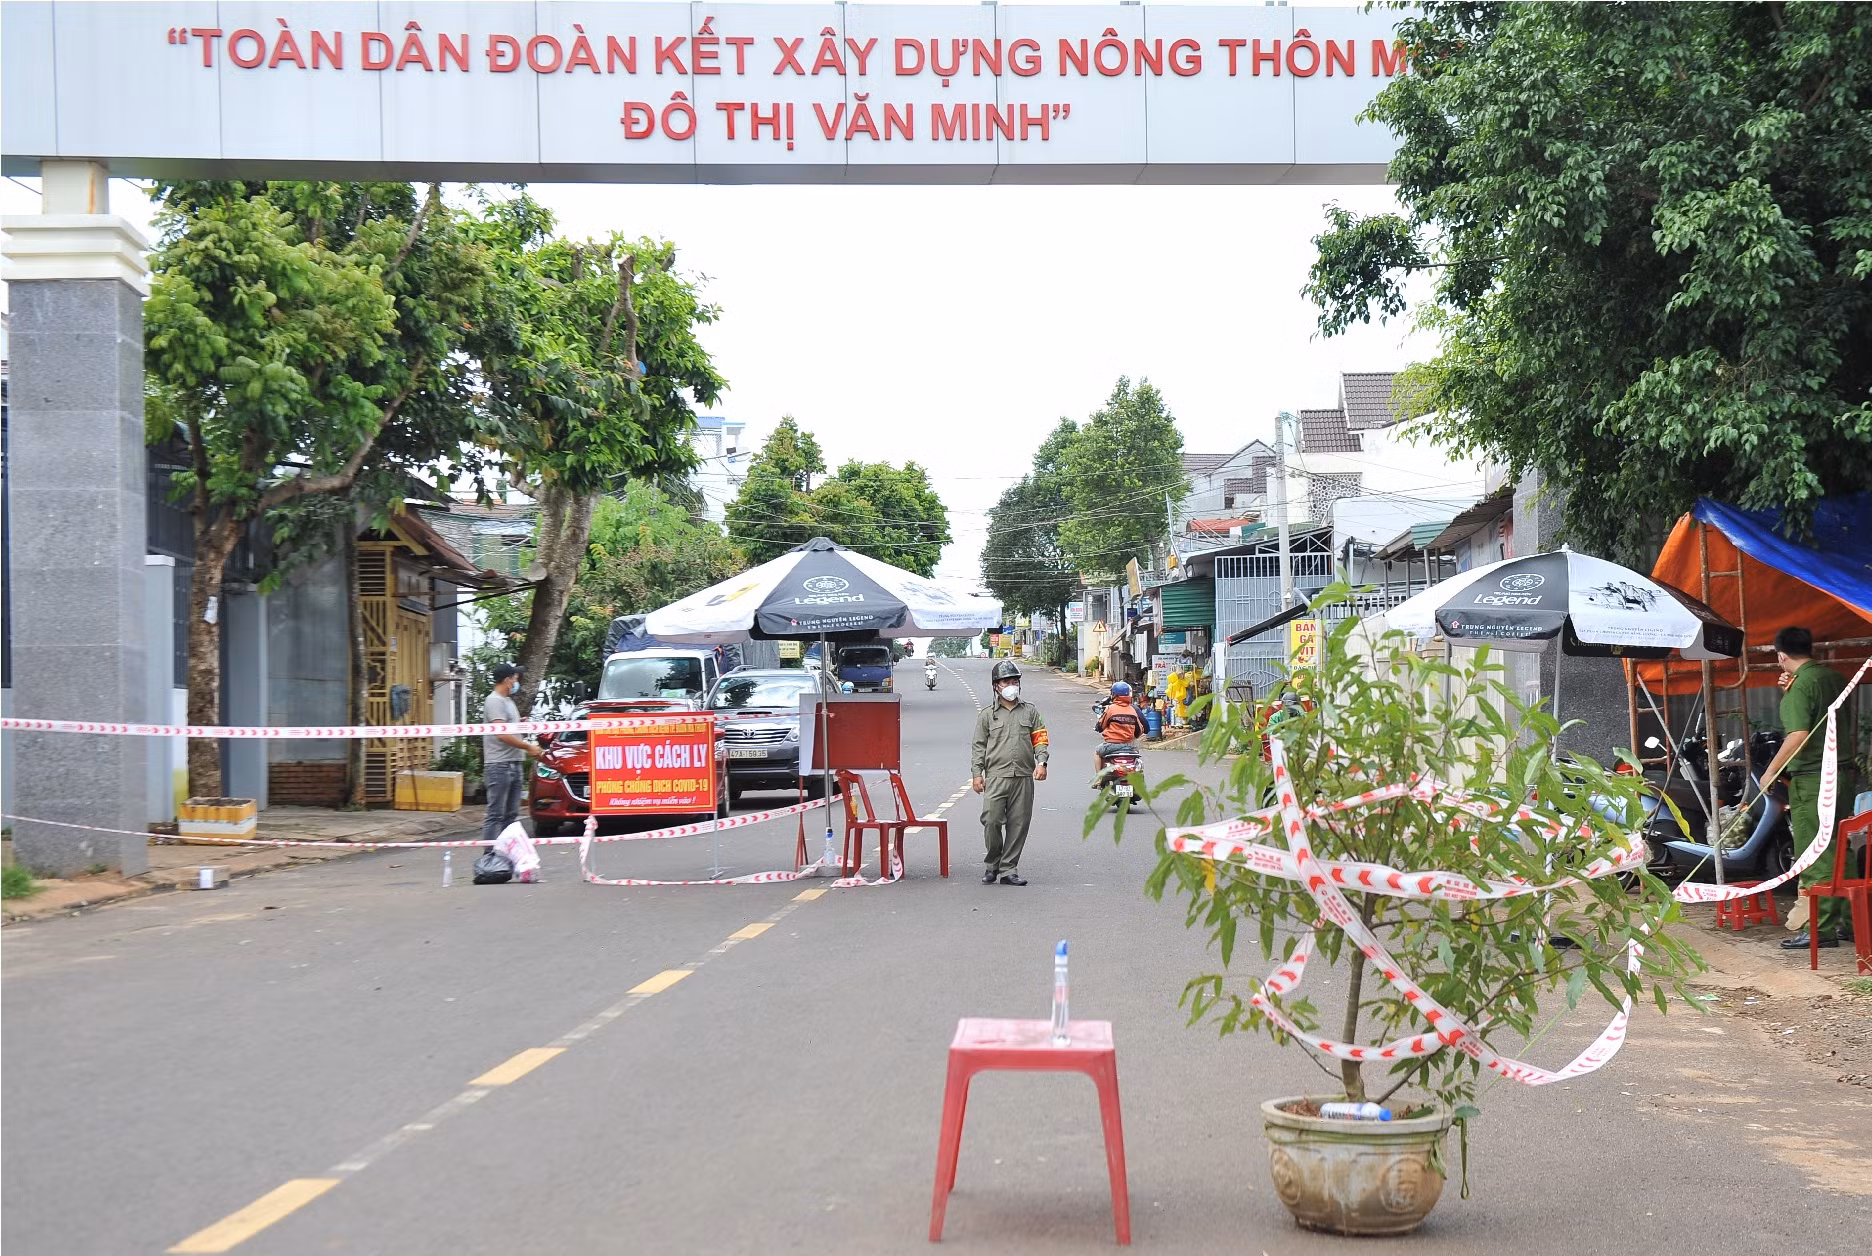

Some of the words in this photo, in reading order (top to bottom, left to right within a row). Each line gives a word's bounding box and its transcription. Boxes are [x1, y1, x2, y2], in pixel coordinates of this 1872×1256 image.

[167, 17, 343, 69] “TOÀN
[361, 21, 470, 72] DÂN
[485, 24, 637, 74] ĐOÀN
[655, 15, 755, 76] KẾT
[774, 27, 878, 76] XÂY
[895, 37, 1042, 87] DỰNG
[1059, 28, 1203, 77] NÔNG
[1219, 28, 1356, 77] THÔN
[621, 91, 697, 141] ĐÔ
[715, 101, 795, 151] THỊ
[813, 93, 914, 141] VĂN
[931, 103, 1071, 141] MINH”
[794, 593, 865, 606] Legend
[1473, 593, 1543, 606] Legend
[822, 616, 847, 624] NGUYÊN
[849, 614, 874, 622] LEGEND
[1295, 621, 1317, 632] BÁN
[595, 745, 623, 770] KHU
[624, 742, 653, 775] VỰC
[654, 739, 691, 769] CÁCH
[693, 743, 708, 768] LY
[595, 777, 623, 794] PHÒNG
[623, 775, 653, 794] CHỐNG
[652, 779, 673, 796] DỊCH
[672, 778, 709, 793] COVID-19
